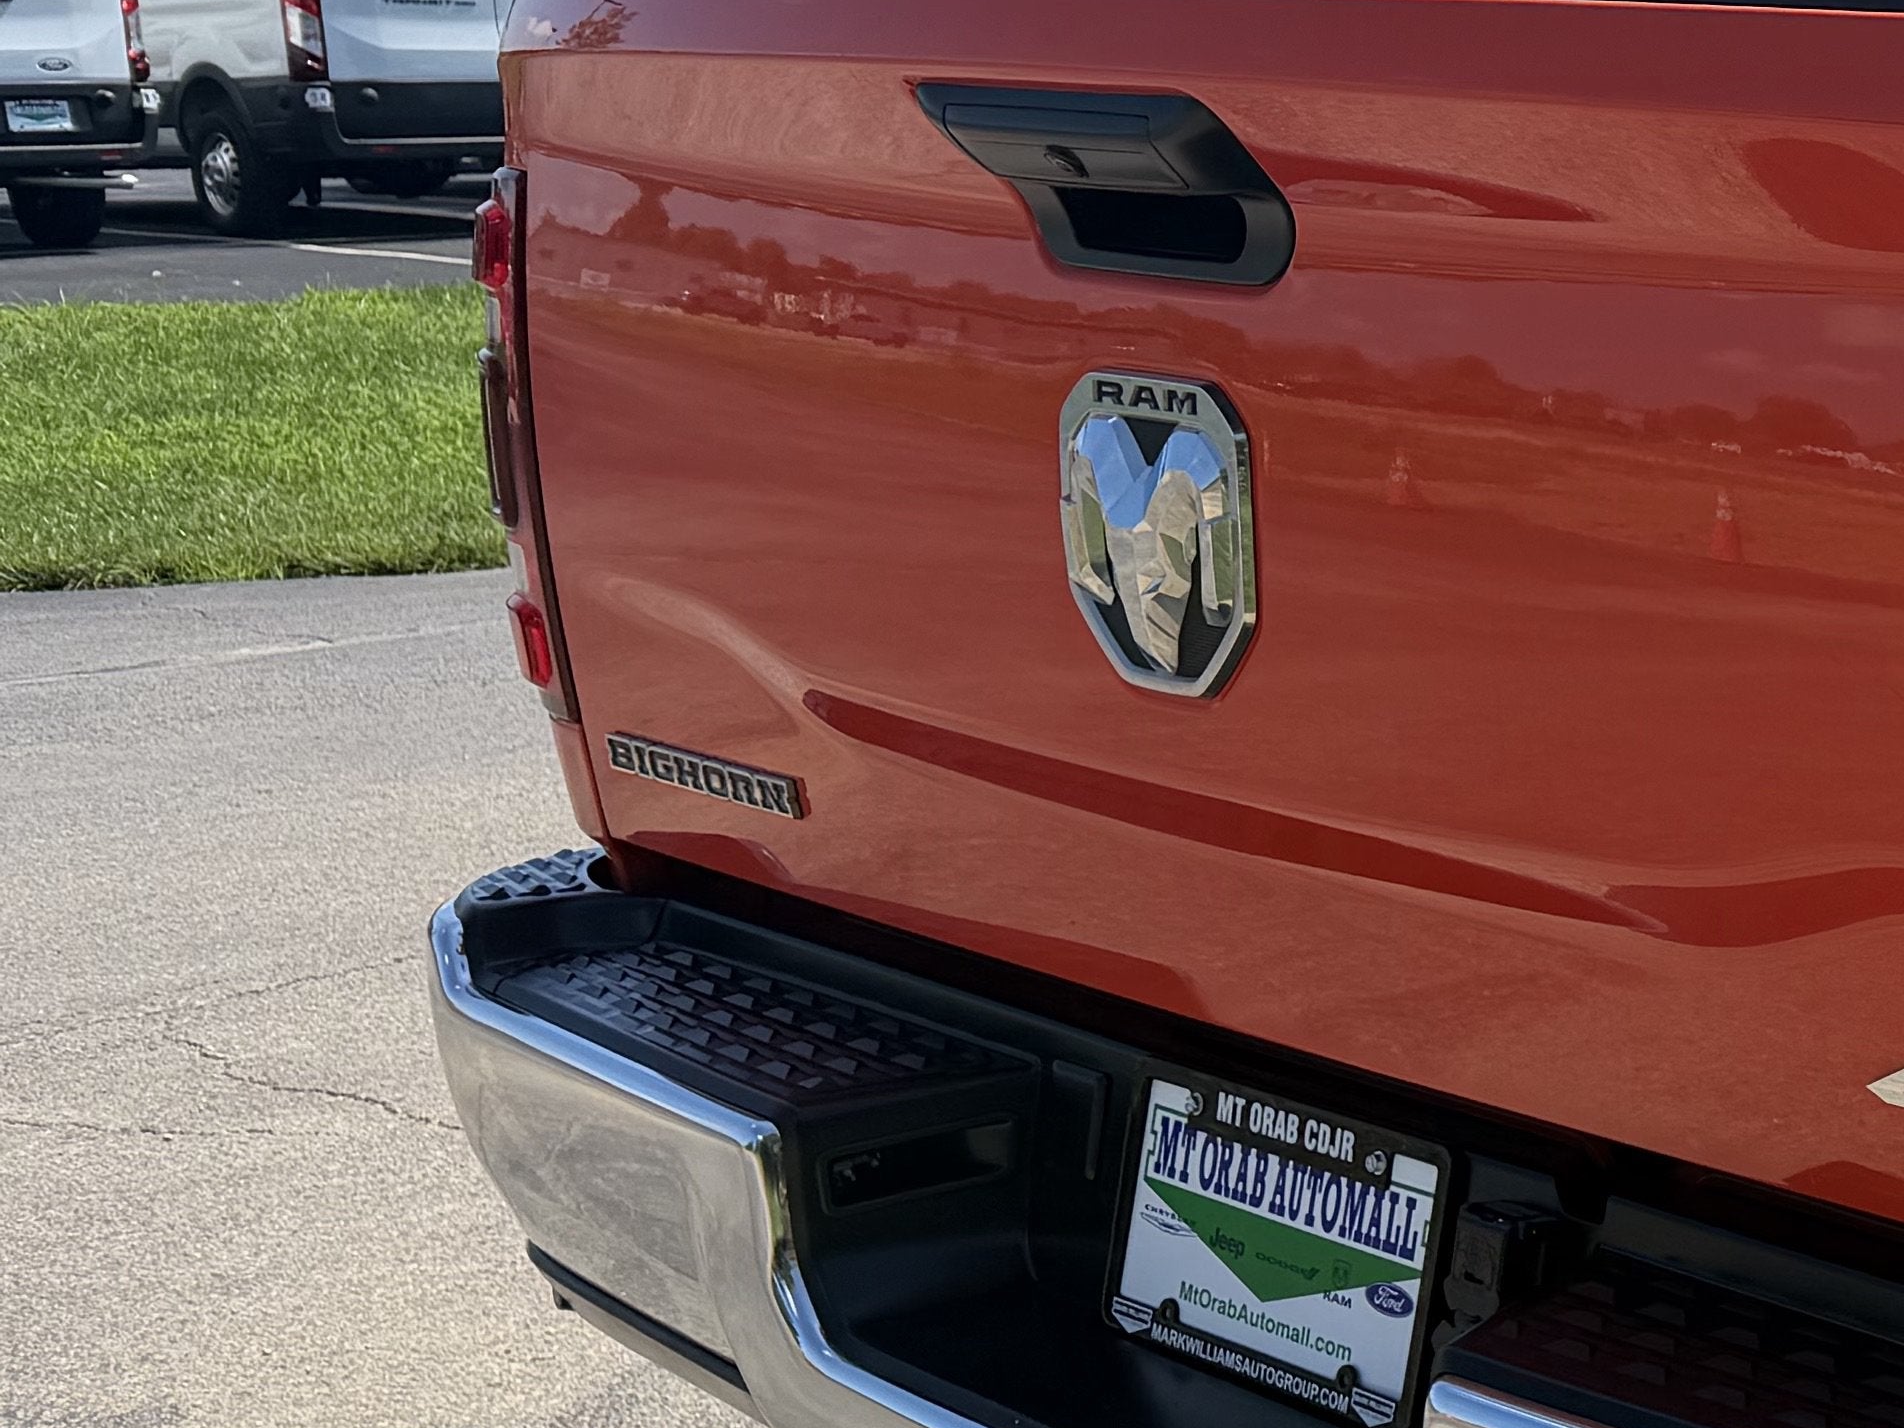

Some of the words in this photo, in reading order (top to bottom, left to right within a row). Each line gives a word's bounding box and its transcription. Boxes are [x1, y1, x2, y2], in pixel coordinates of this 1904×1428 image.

[1092, 379, 1198, 416] RAM
[605, 732, 803, 820] BIGHORN
[1216, 1091, 1247, 1127] MT
[1248, 1101, 1300, 1145] ORAB
[1303, 1118, 1356, 1163] CDJR
[1153, 1116, 1197, 1184] MT
[1198, 1130, 1270, 1209] ORAB
[1268, 1159, 1420, 1262] AUTOMALL
[1209, 1227, 1246, 1260] Jeep
[1178, 1280, 1353, 1363] MtOrabAutomall.com
[1323, 1289, 1353, 1309] RAM
[1372, 1285, 1406, 1315] Ford
[1150, 1322, 1350, 1415] MARKWILLIAMSAUTOGROUP.COM
